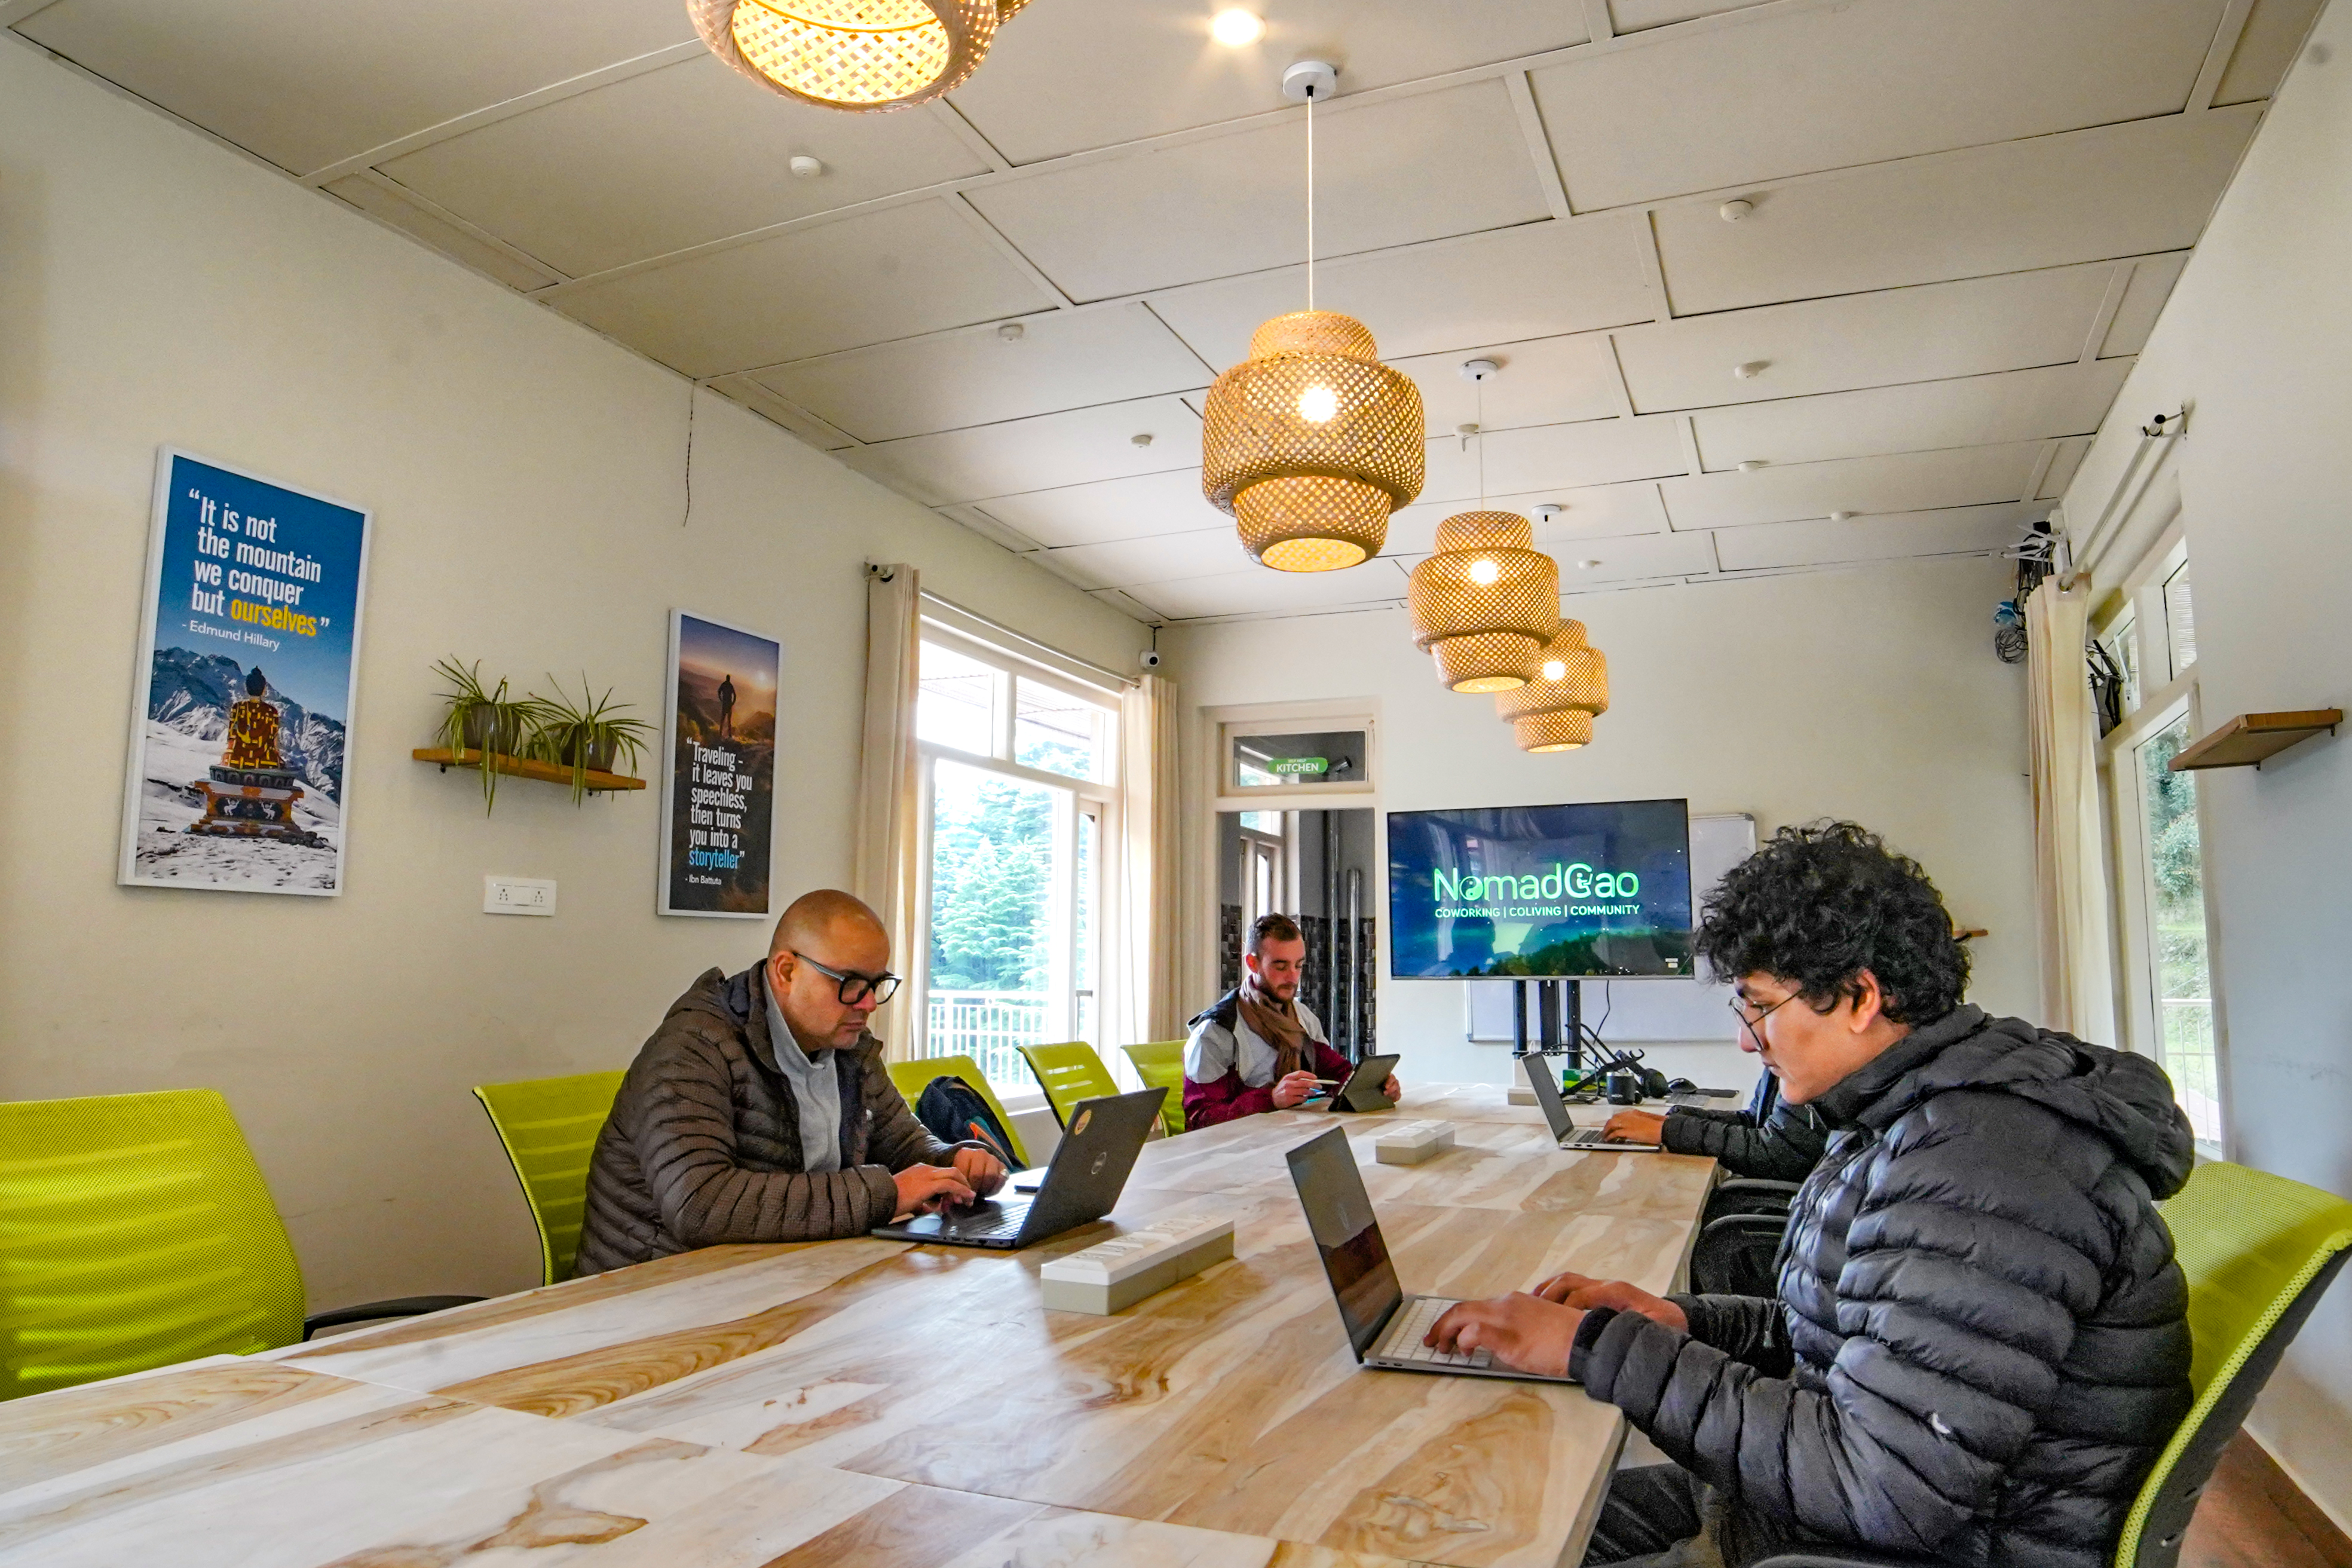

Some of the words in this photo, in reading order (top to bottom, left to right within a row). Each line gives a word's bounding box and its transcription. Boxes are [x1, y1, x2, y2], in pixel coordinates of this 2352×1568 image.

[222, 503, 240, 532] is
[245, 516, 277, 544] not
[198, 526, 230, 559] the
[236, 541, 321, 583] mountain
[194, 560, 222, 586] we
[228, 569, 304, 605] conquer
[192, 583, 225, 617] but
[189, 620, 241, 641] Edmund
[244, 631, 280, 652] Hillary
[692, 762, 700, 783] it
[703, 764, 733, 788] leaves
[735, 774, 752, 793] you
[1276, 763, 1319, 773] KITCHEN
[691, 787, 748, 813] speechless,
[690, 804, 713, 826] then
[716, 807, 742, 829] turns
[689, 829, 708, 849] you
[710, 826, 729, 848] into
[731, 834, 738, 849] a
[688, 874, 699, 883] Ibn
[700, 875, 722, 885] Battuta
[1435, 906, 1500, 918] COWORKING
[1509, 905, 1561, 917] COLIVING
[1570, 904, 1640, 916] COMMUNITY
